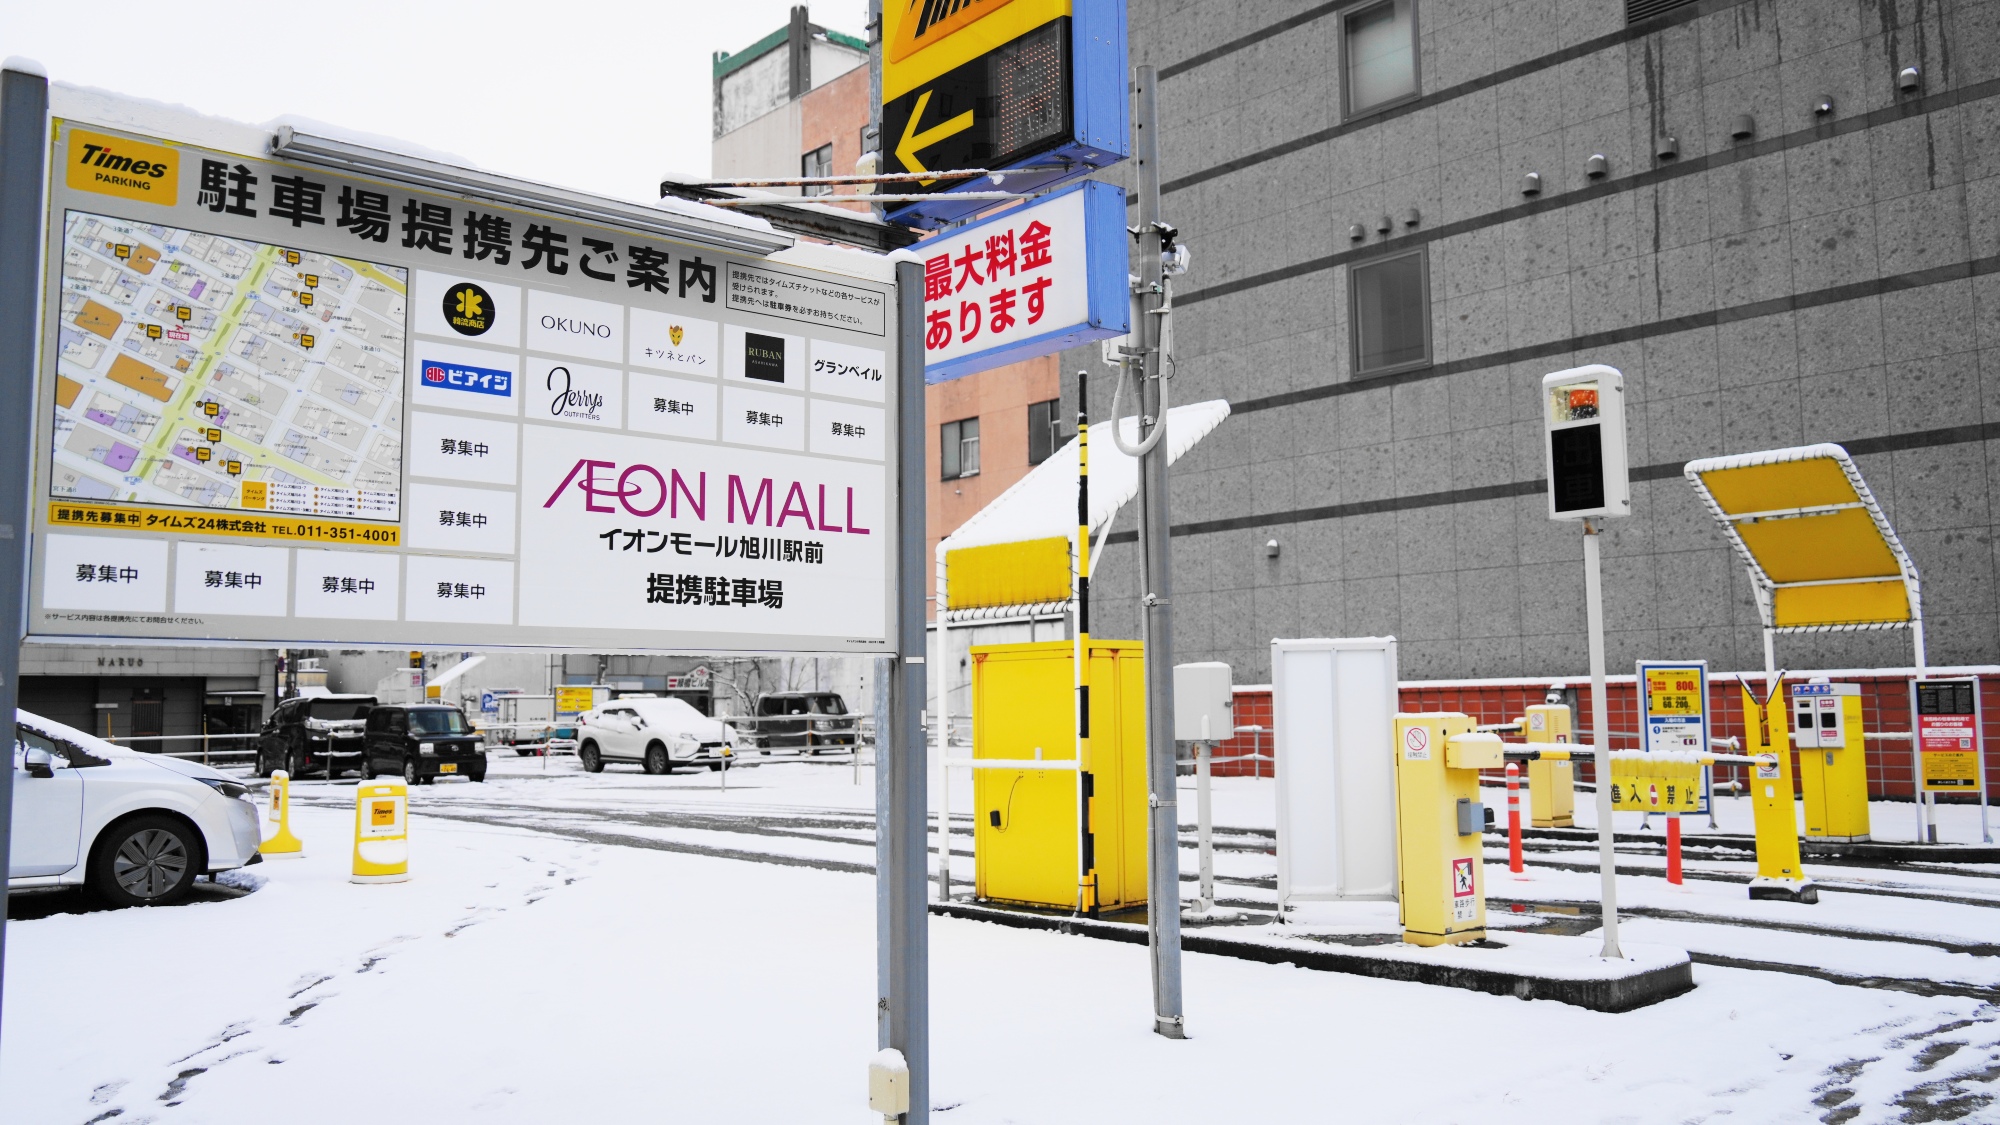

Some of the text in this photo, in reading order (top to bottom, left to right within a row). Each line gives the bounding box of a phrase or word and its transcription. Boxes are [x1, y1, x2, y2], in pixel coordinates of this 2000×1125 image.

[79, 143, 168, 178] Times
[95, 172, 151, 190] PARKING
[197, 158, 718, 303] 駐車場提携先ご案内
[924, 220, 1052, 302] 最大料金
[731, 282, 779, 298] 受けられます。
[732, 270, 880, 306] 提携先ではタイムズチケットなどの各サービスが
[925, 276, 1052, 351] あります
[541, 315, 611, 339] OKUNO
[748, 346, 782, 361] RUBAN
[814, 359, 882, 382] グランベイル
[547, 366, 603, 416] Jerrys
[564, 410, 601, 421] OUTFITTERS
[654, 397, 694, 416] 募集中
[746, 410, 783, 427] 募集中
[831, 422, 866, 439] 募集中
[441, 438, 489, 458] 募集中
[727, 474, 871, 535] MALL
[57, 508, 140, 525] 提携先募集中
[146, 513, 267, 533] タイムズ24株式会社
[439, 510, 488, 529] 募集中
[600, 528, 824, 564] イオンモール旭川駅前
[76, 563, 139, 584] 募集中
[204, 570, 262, 590] 募集中
[322, 576, 375, 595] 募集中
[437, 582, 486, 600] 募集中
[647, 572, 784, 609] 提携駐車場
[97, 657, 144, 667] MARUO
